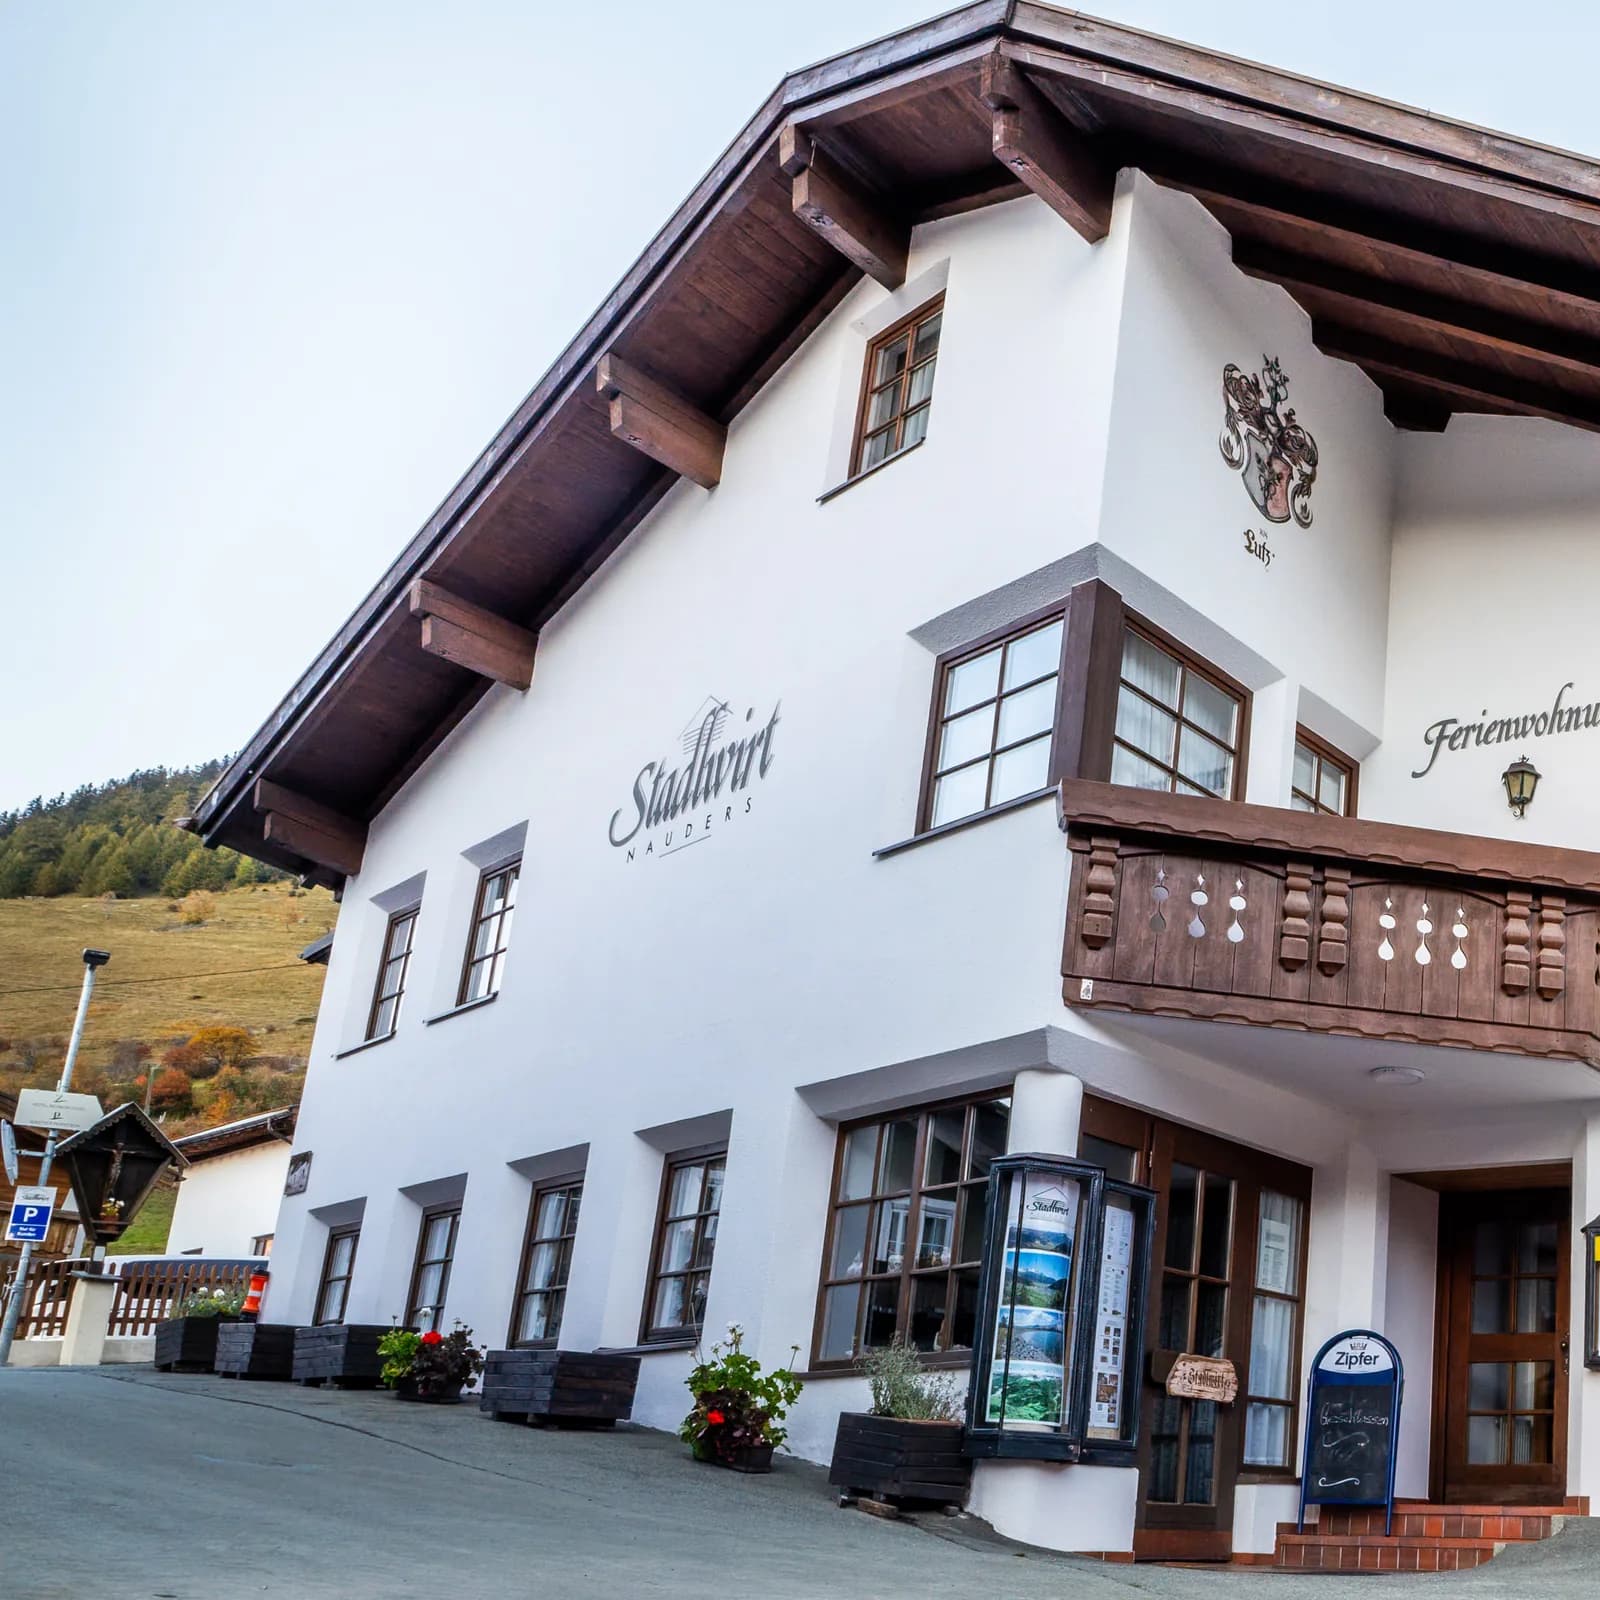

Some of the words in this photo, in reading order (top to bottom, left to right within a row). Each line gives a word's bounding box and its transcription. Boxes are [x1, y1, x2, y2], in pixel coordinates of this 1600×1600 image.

[609, 699, 782, 847] Stadlwirt
[626, 797, 752, 863] NAUDERS
[23, 1207, 38, 1222] P
[1335, 1351, 1380, 1370] Zipfer
